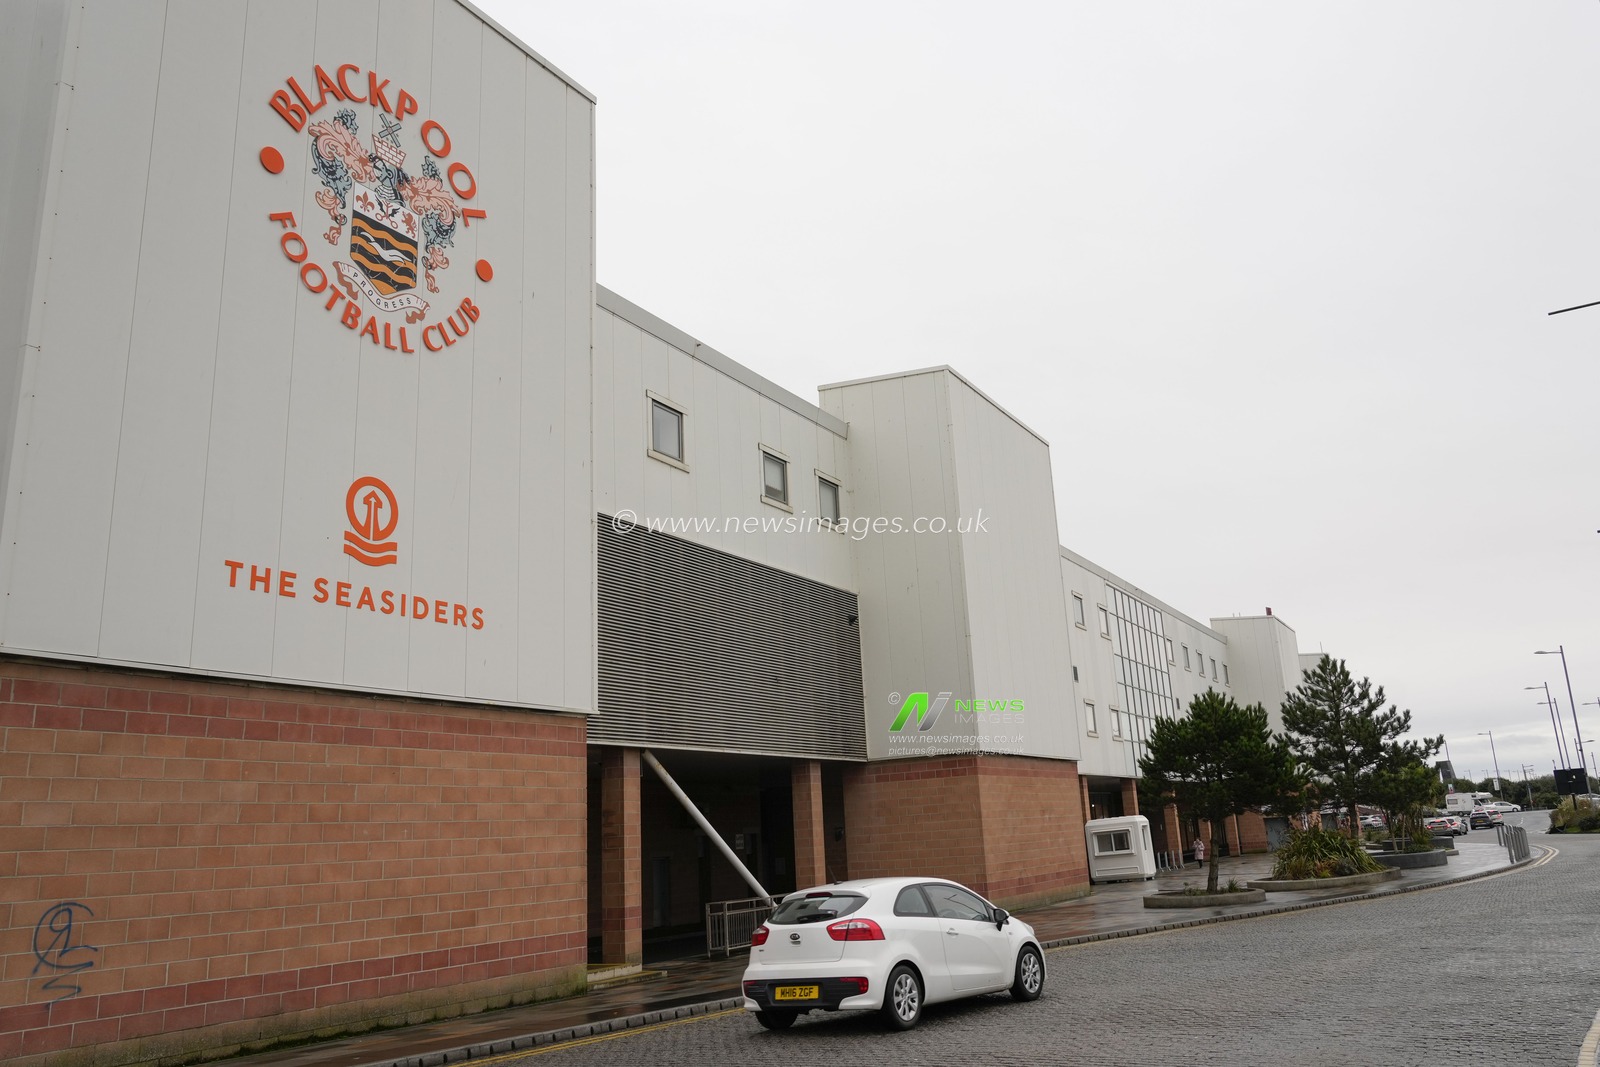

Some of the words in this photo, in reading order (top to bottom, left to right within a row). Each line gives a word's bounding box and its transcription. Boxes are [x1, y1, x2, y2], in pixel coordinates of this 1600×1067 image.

[269, 63, 487, 227] BLACKPOOL
[269, 211, 415, 353] FOOTBALL
[422, 297, 480, 351] CLUB
[353, 272, 412, 309] PROGRESS
[224, 559, 297, 598] THE
[312, 577, 484, 630] SEASIDERS
[780, 987, 797, 998] MH16
[798, 987, 814, 997] ZGF
